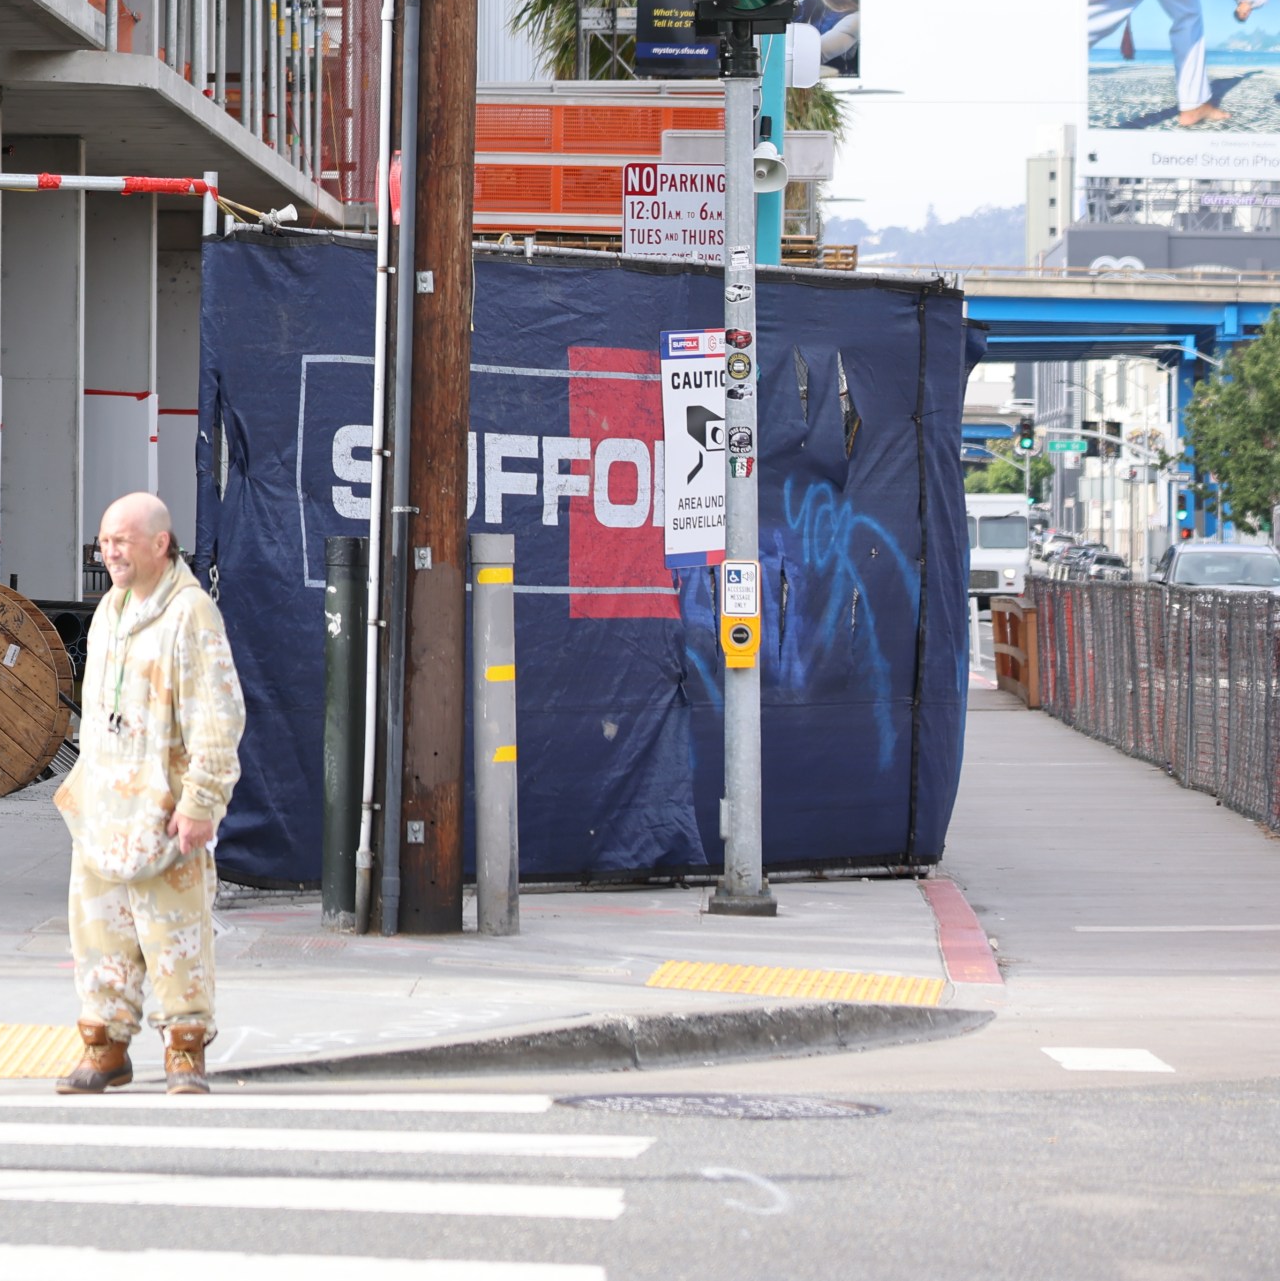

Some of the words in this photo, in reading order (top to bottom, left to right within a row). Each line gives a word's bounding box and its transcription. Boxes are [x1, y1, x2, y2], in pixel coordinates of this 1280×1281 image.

[653, 8, 679, 17] What's
[653, 19, 667, 28] Tell
[667, 19, 674, 28] it
[674, 20, 683, 28] at
[651, 46, 709, 56] mystory.sfsu.edu
[1151, 151, 1198, 167] Dance!
[1201, 152, 1231, 168] Shot
[1233, 156, 1249, 168] on
[627, 166, 656, 192] NO
[659, 173, 726, 193] PARKING
[687, 211, 696, 219] TO
[629, 228, 662, 245] TUES
[664, 232, 679, 241] AND
[681, 229, 725, 246] THURS
[671, 340, 698, 349] SUFFOLK
[677, 497, 702, 511] AREA
[730, 593, 751, 601] MESSAGE
